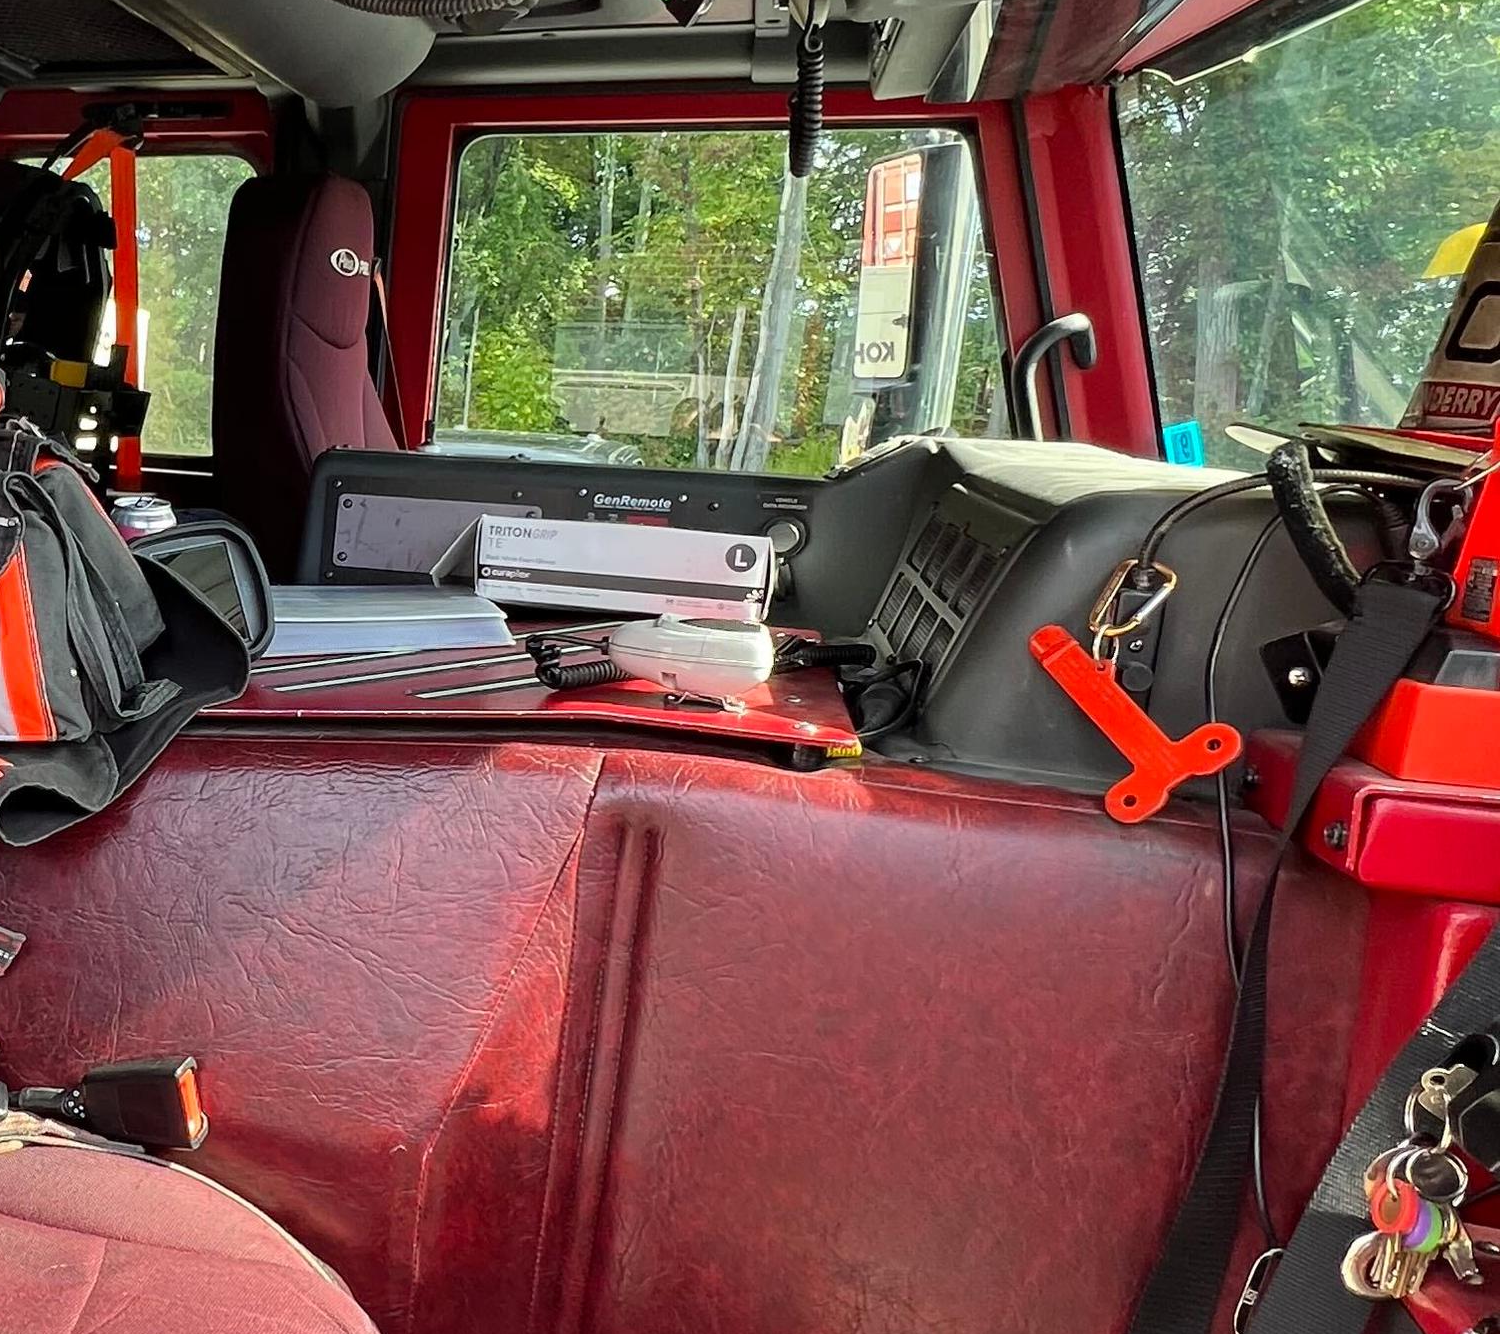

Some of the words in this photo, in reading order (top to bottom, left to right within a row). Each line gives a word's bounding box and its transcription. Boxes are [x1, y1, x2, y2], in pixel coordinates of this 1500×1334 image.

[1426, 384, 1500, 416] DERRY
[594, 493, 672, 508] GenRemote
[735, 549, 748, 567] L
